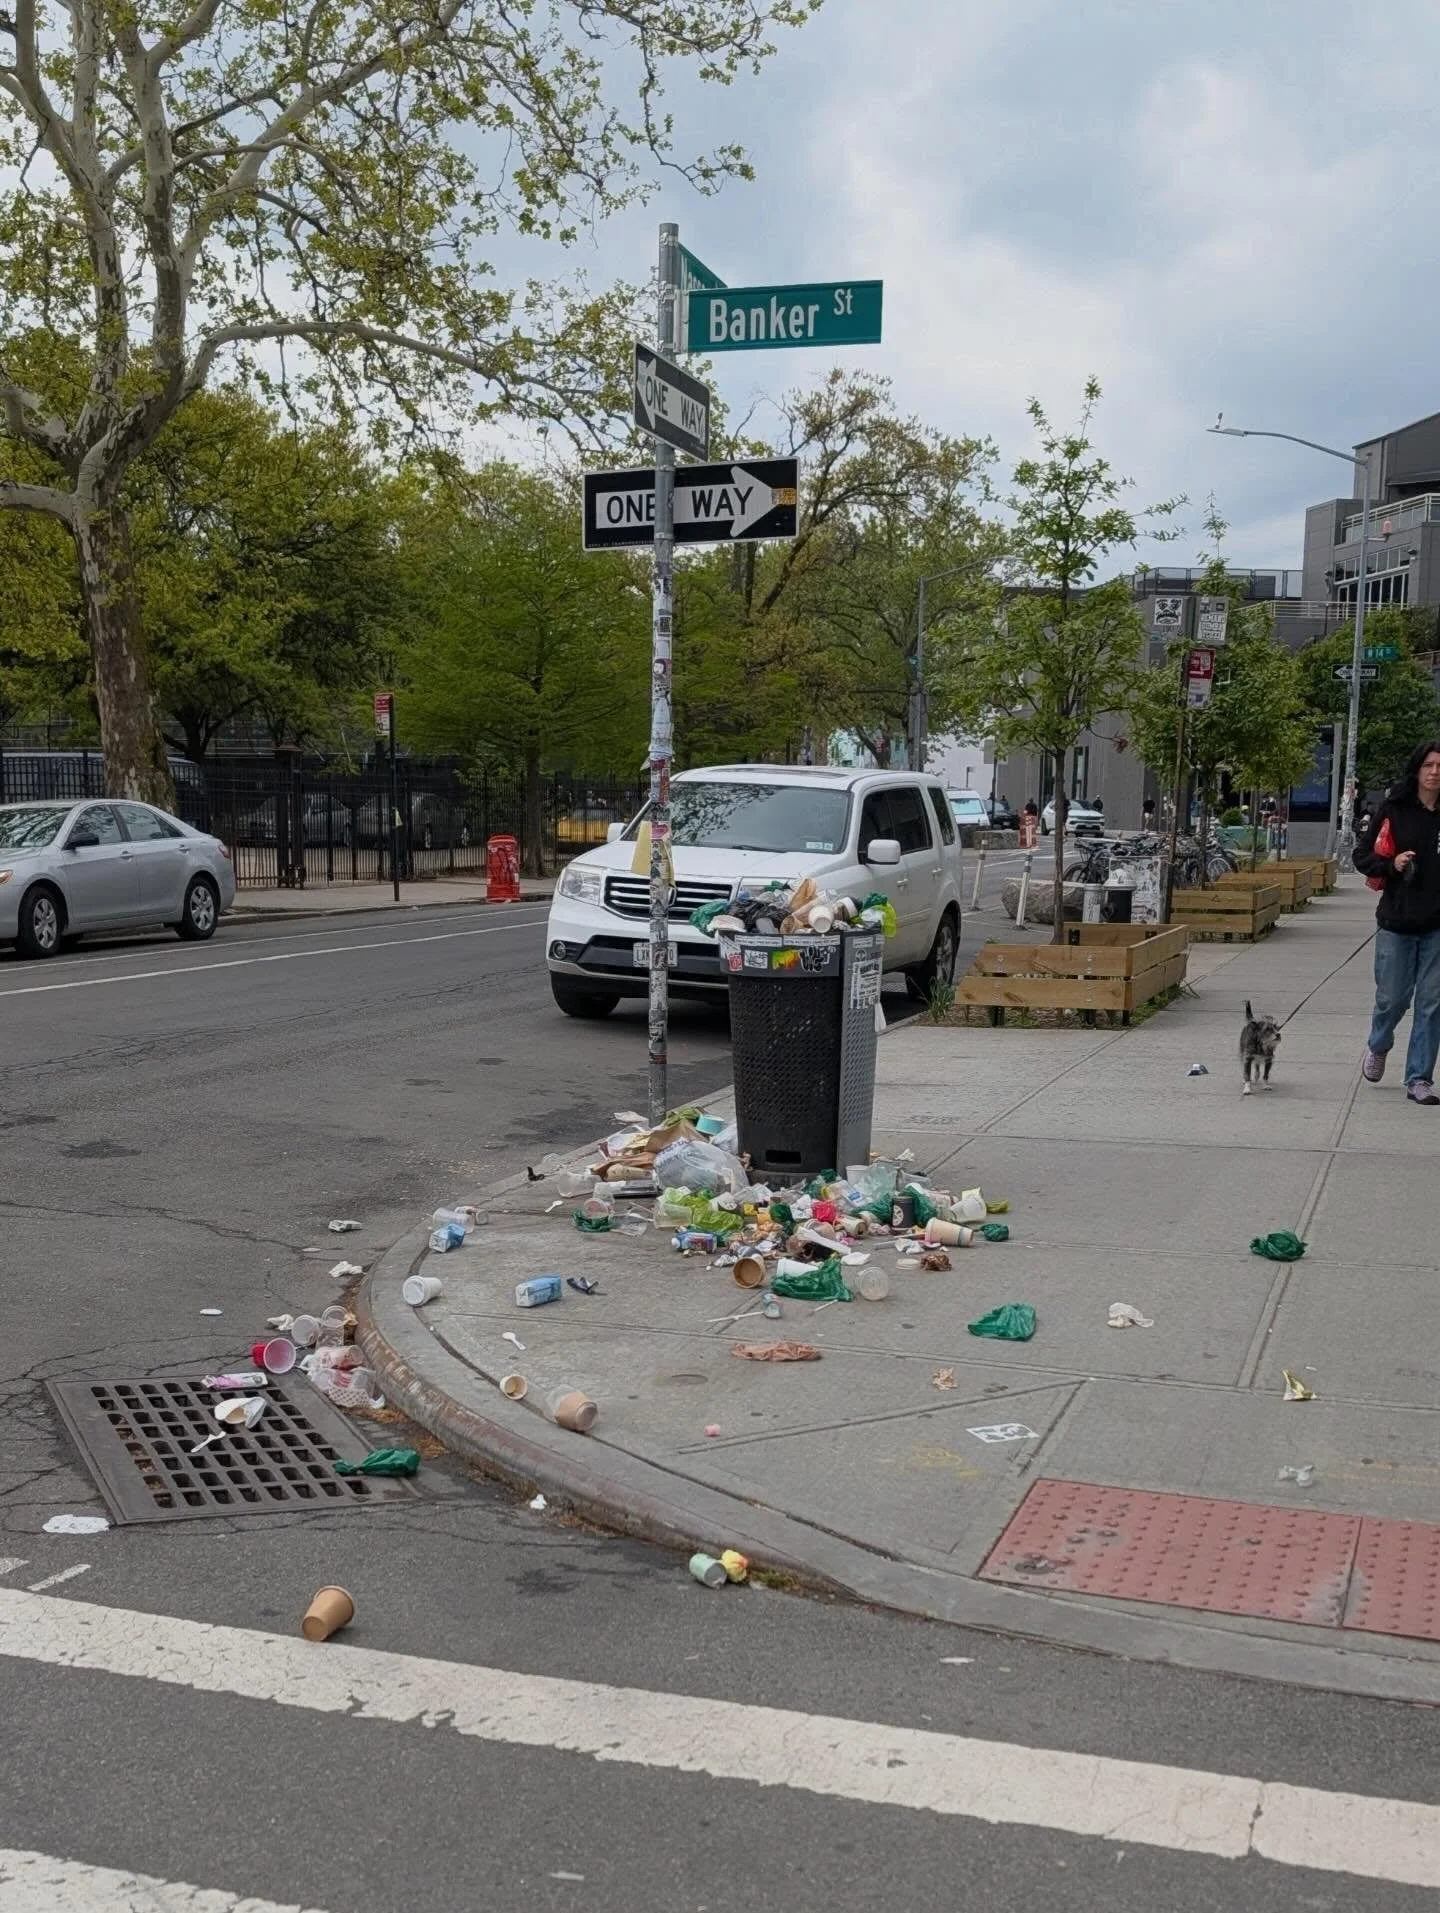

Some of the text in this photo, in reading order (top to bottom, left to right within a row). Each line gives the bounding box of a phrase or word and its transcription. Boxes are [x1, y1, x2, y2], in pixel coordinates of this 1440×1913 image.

[709, 289, 853, 342] Banker St
[645, 375, 703, 436] ONE WAY
[606, 494, 656, 524] ONE
[692, 486, 754, 518] WAY
